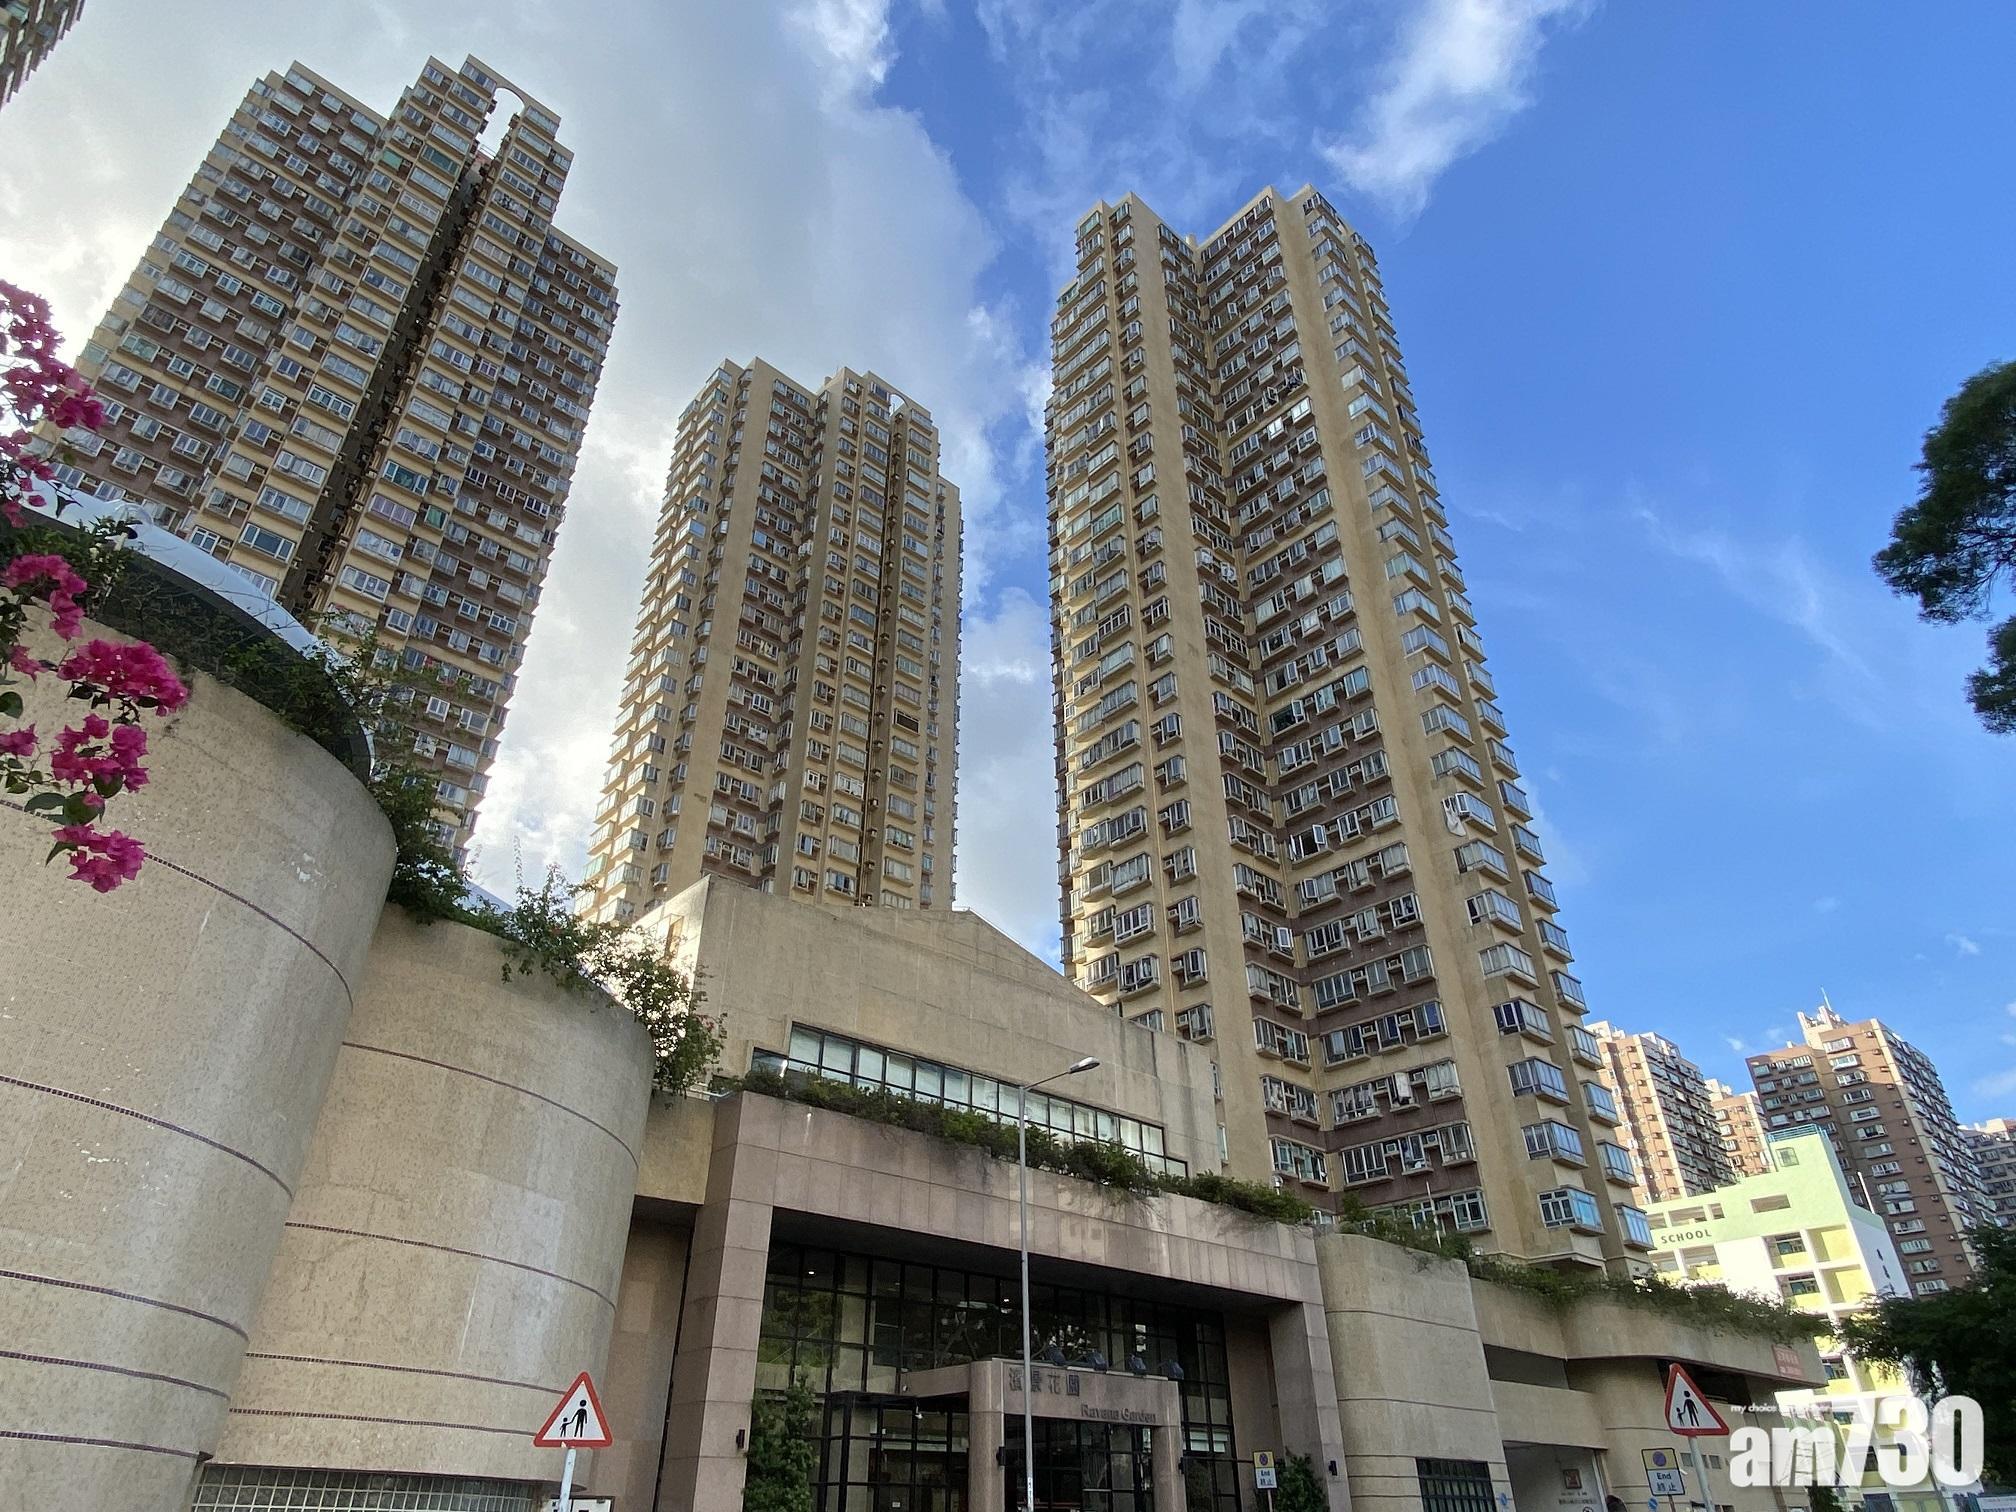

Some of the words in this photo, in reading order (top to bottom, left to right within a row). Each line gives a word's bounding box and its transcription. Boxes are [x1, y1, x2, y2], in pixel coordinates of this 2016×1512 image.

[1661, 1229, 1712, 1244] SCHOOL
[1121, 1408, 1156, 1423] Garden
[1656, 1472, 1672, 1480] End
